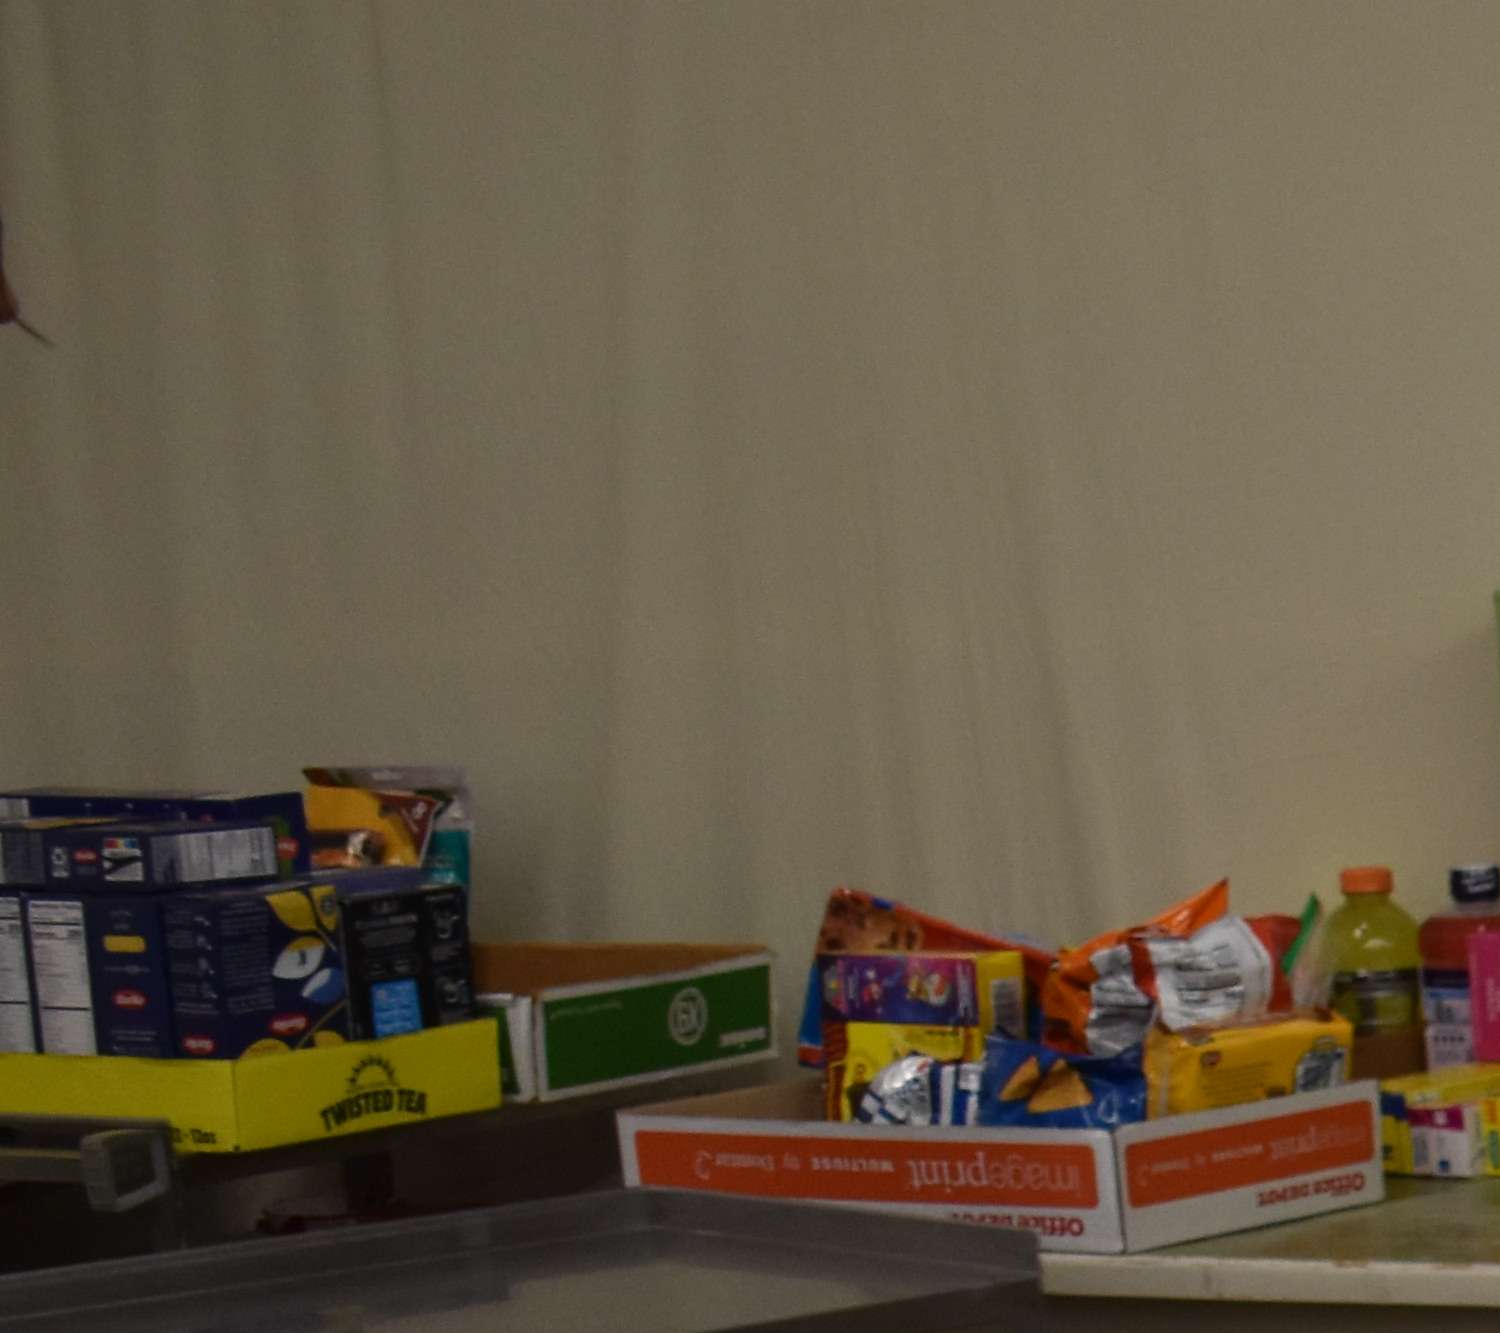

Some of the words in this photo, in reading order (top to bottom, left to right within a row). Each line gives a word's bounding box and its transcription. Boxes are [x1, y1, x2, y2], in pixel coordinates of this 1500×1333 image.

[319, 1086, 396, 1134] TWISTED
[396, 1086, 428, 1115] TEA
[905, 1149, 1082, 1192] imageprint
